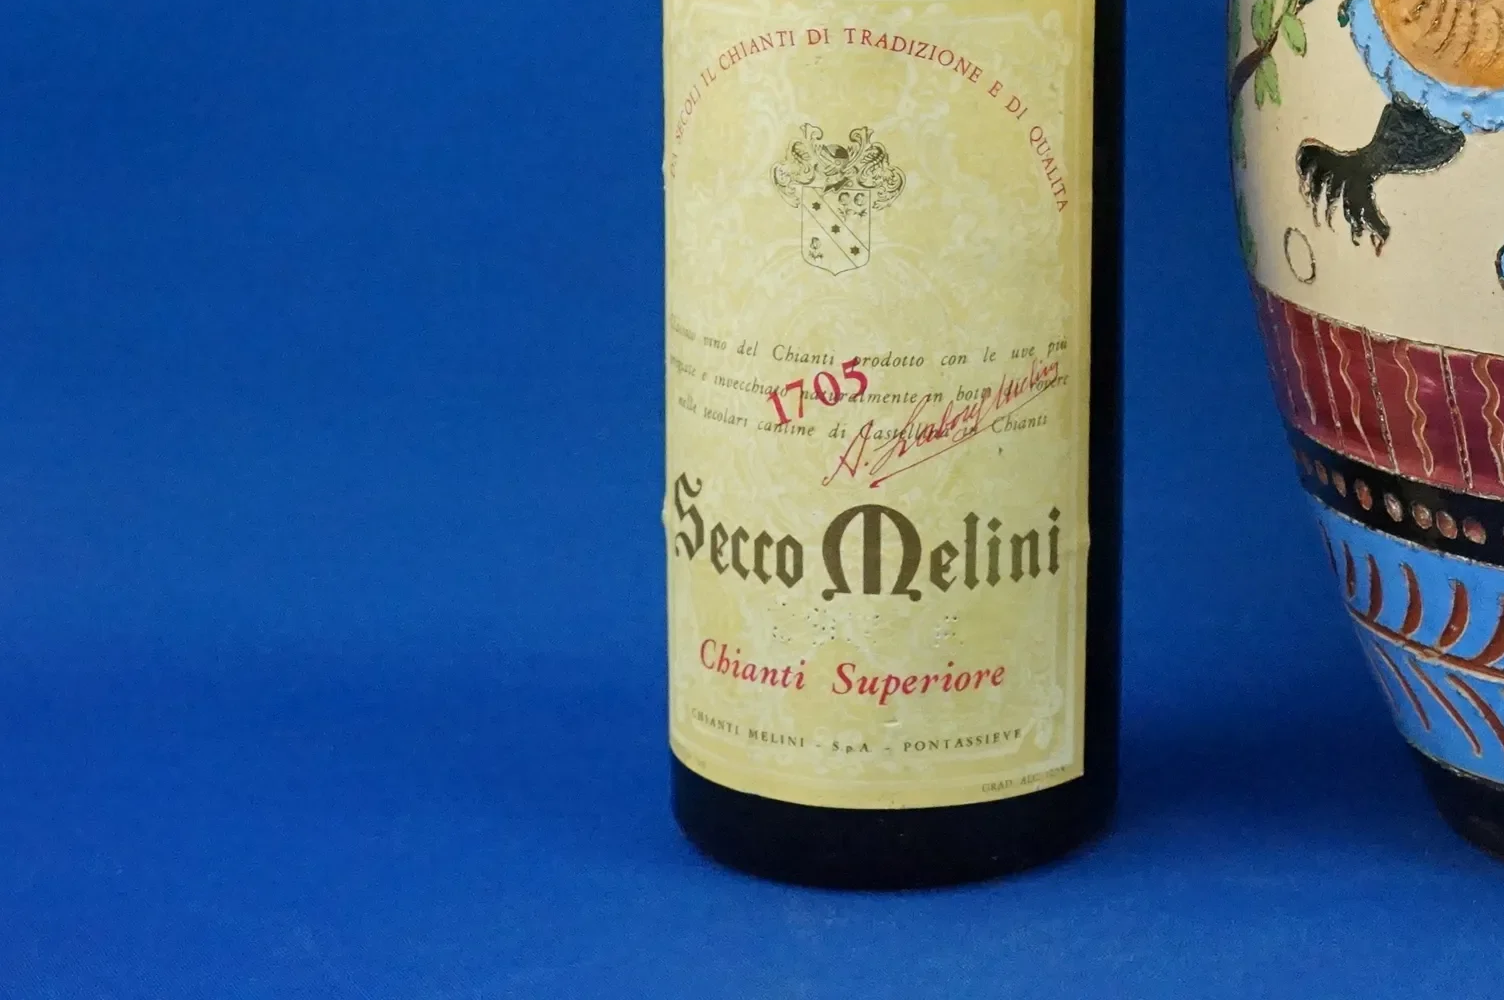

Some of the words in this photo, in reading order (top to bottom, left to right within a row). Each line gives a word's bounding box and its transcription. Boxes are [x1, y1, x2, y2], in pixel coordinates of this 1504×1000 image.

[700, 67, 717, 87] IL
[718, 30, 796, 71] CHIANTI
[807, 28, 830, 46] DI
[844, 28, 984, 84] TRADIZIONE
[988, 80, 1004, 98] E
[1004, 96, 1029, 120] DI
[1028, 125, 1069, 214] QUALITA
[703, 336, 728, 351] vino
[736, 339, 759, 357] del
[772, 344, 837, 366] Chianti
[850, 349, 925, 371] prodotto
[940, 353, 968, 366] con
[982, 346, 997, 363] le
[1011, 345, 1036, 360] uve
[713, 374, 788, 398] invecchiato
[767, 357, 869, 426] 1705
[703, 407, 748, 428] secolari
[757, 421, 816, 438] cantine
[828, 422, 847, 438] di
[991, 414, 1048, 434] Chianti
[674, 472, 804, 590] Secco
[821, 504, 1061, 602] Melini
[700, 638, 805, 691] Chianti
[832, 661, 1006, 706] Superiore
[691, 708, 740, 736] CHIANTI
[748, 728, 804, 748] MELINI
[903, 728, 1022, 753] PONTASSIEVE
